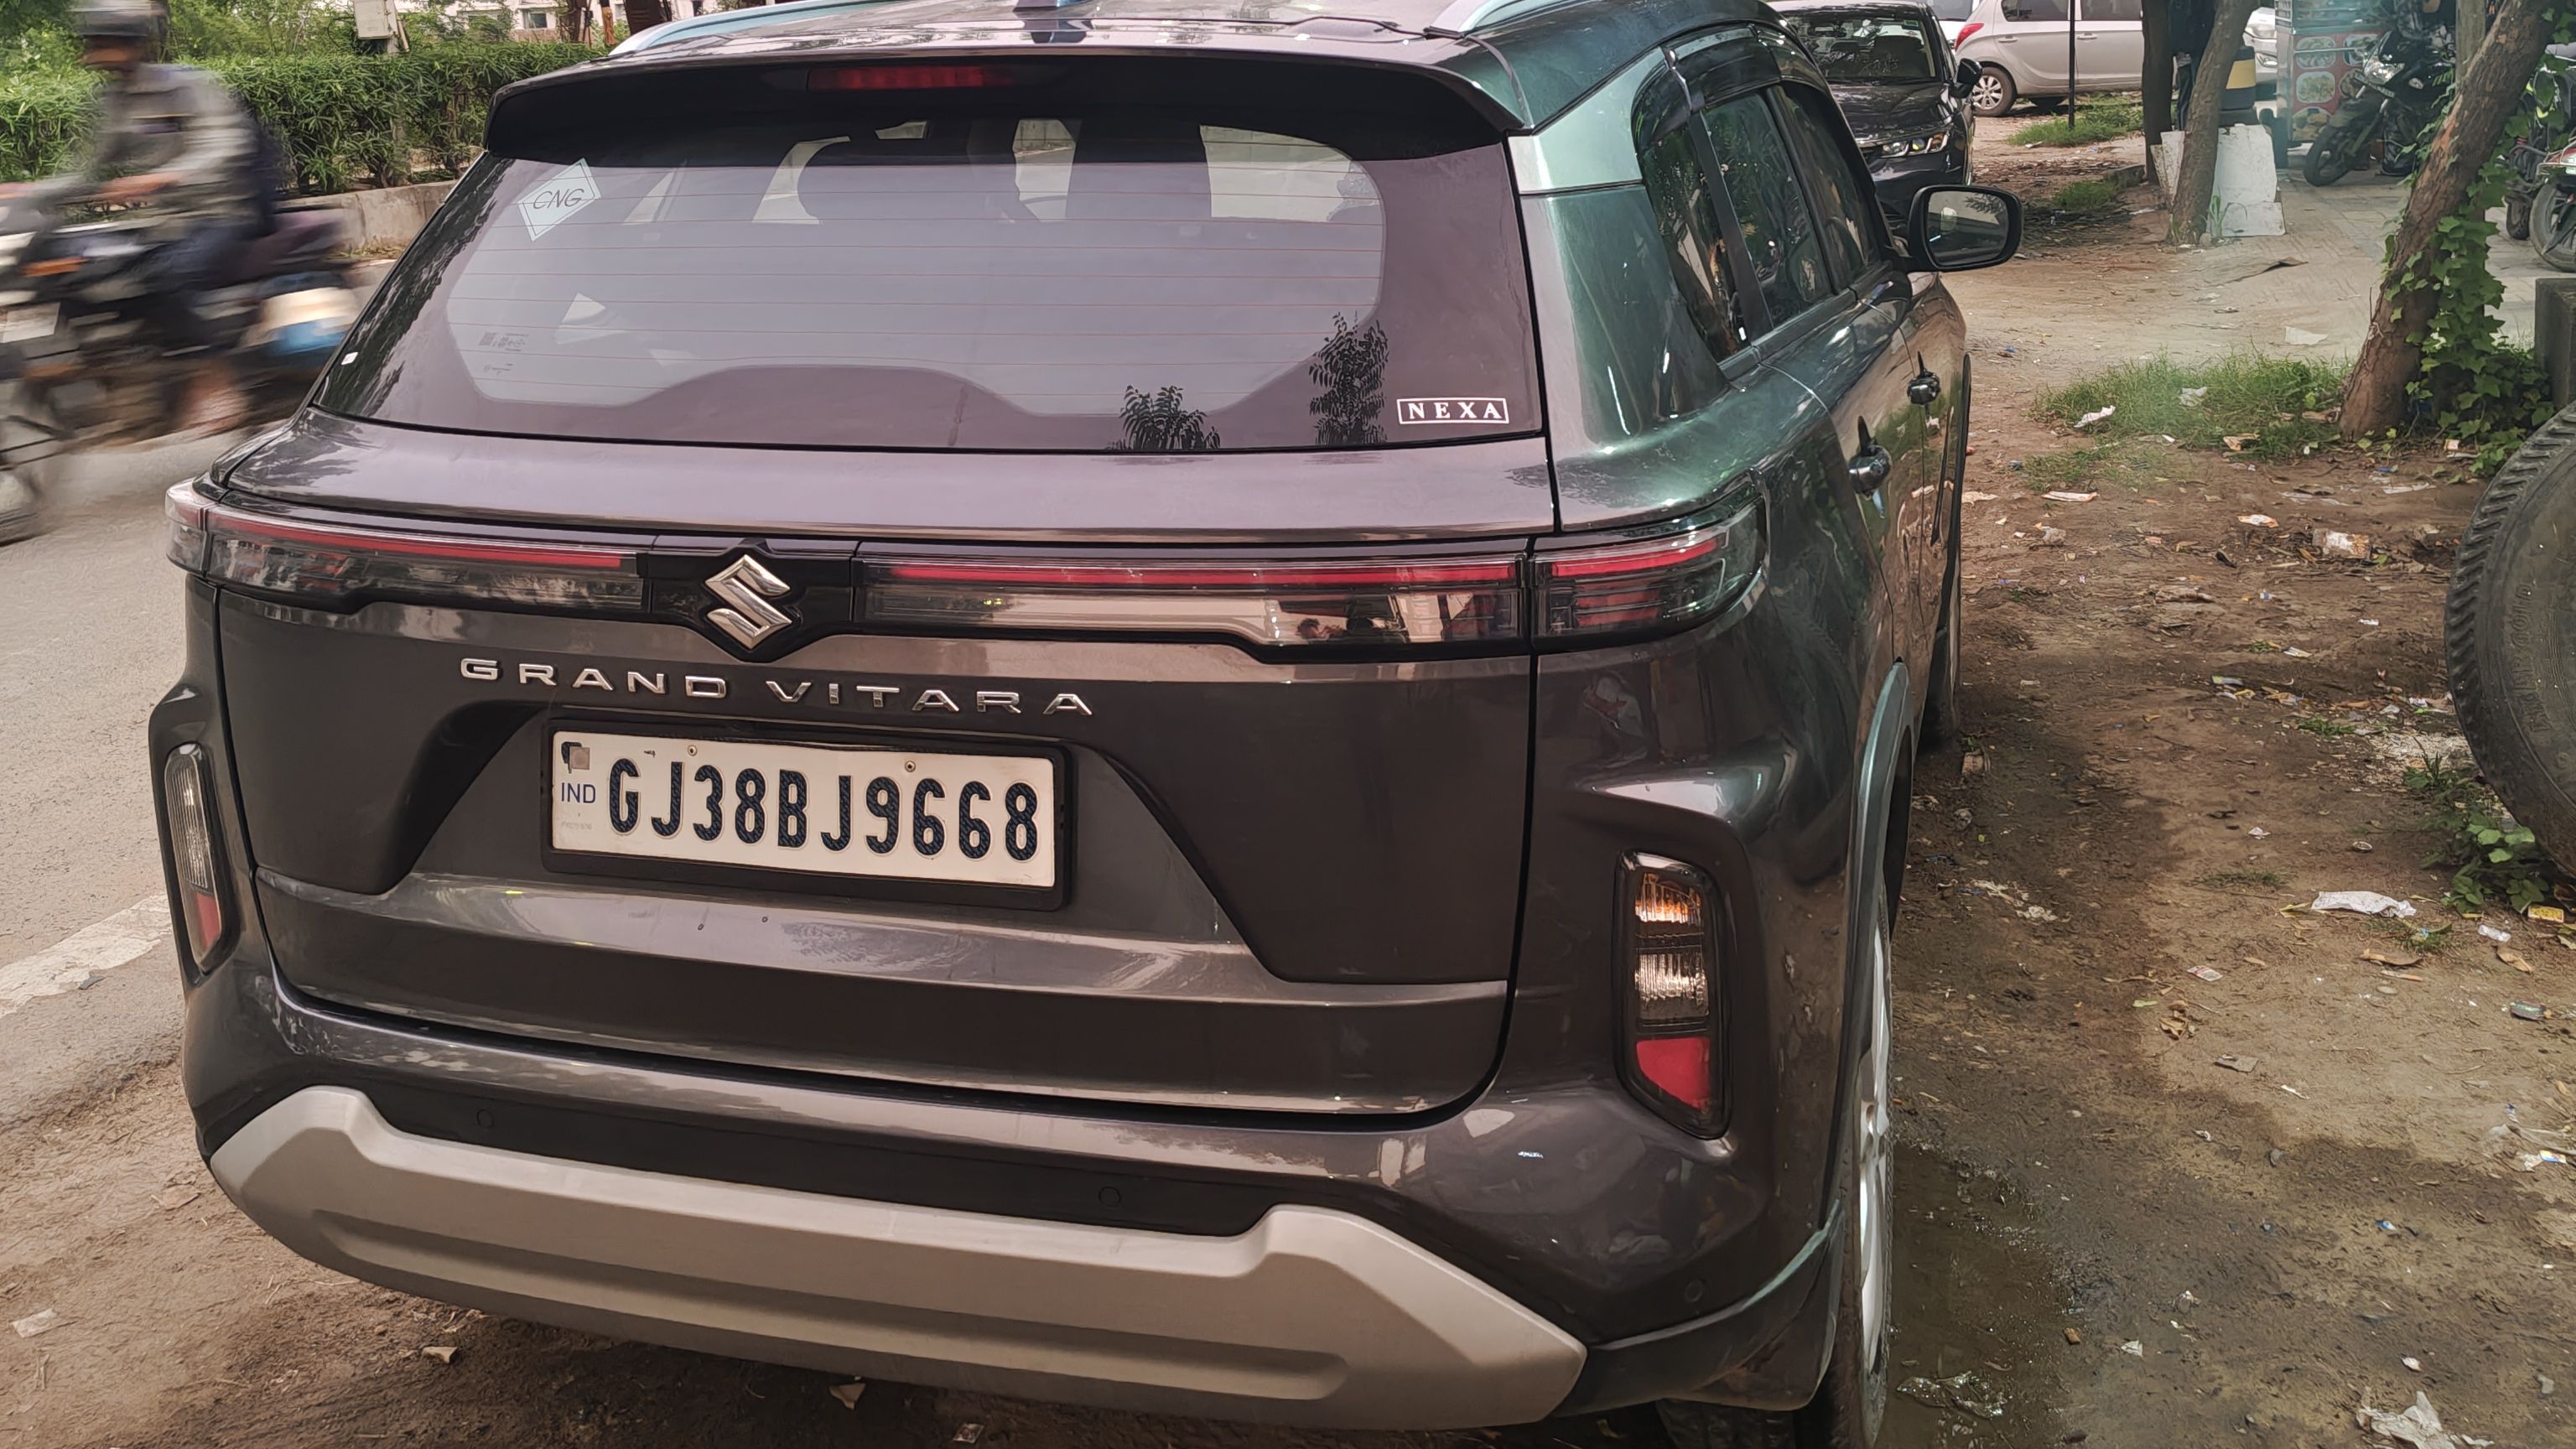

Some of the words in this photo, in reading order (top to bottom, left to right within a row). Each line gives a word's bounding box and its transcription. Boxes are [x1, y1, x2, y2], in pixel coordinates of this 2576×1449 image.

[532, 188, 585, 210] CNG
[1407, 402, 1503, 420] NEXA
[460, 657, 729, 699] GRAND
[765, 678, 1094, 717] VITARA
[560, 782, 596, 803] IND
[608, 756, 1041, 863] GJ38BJ9668
